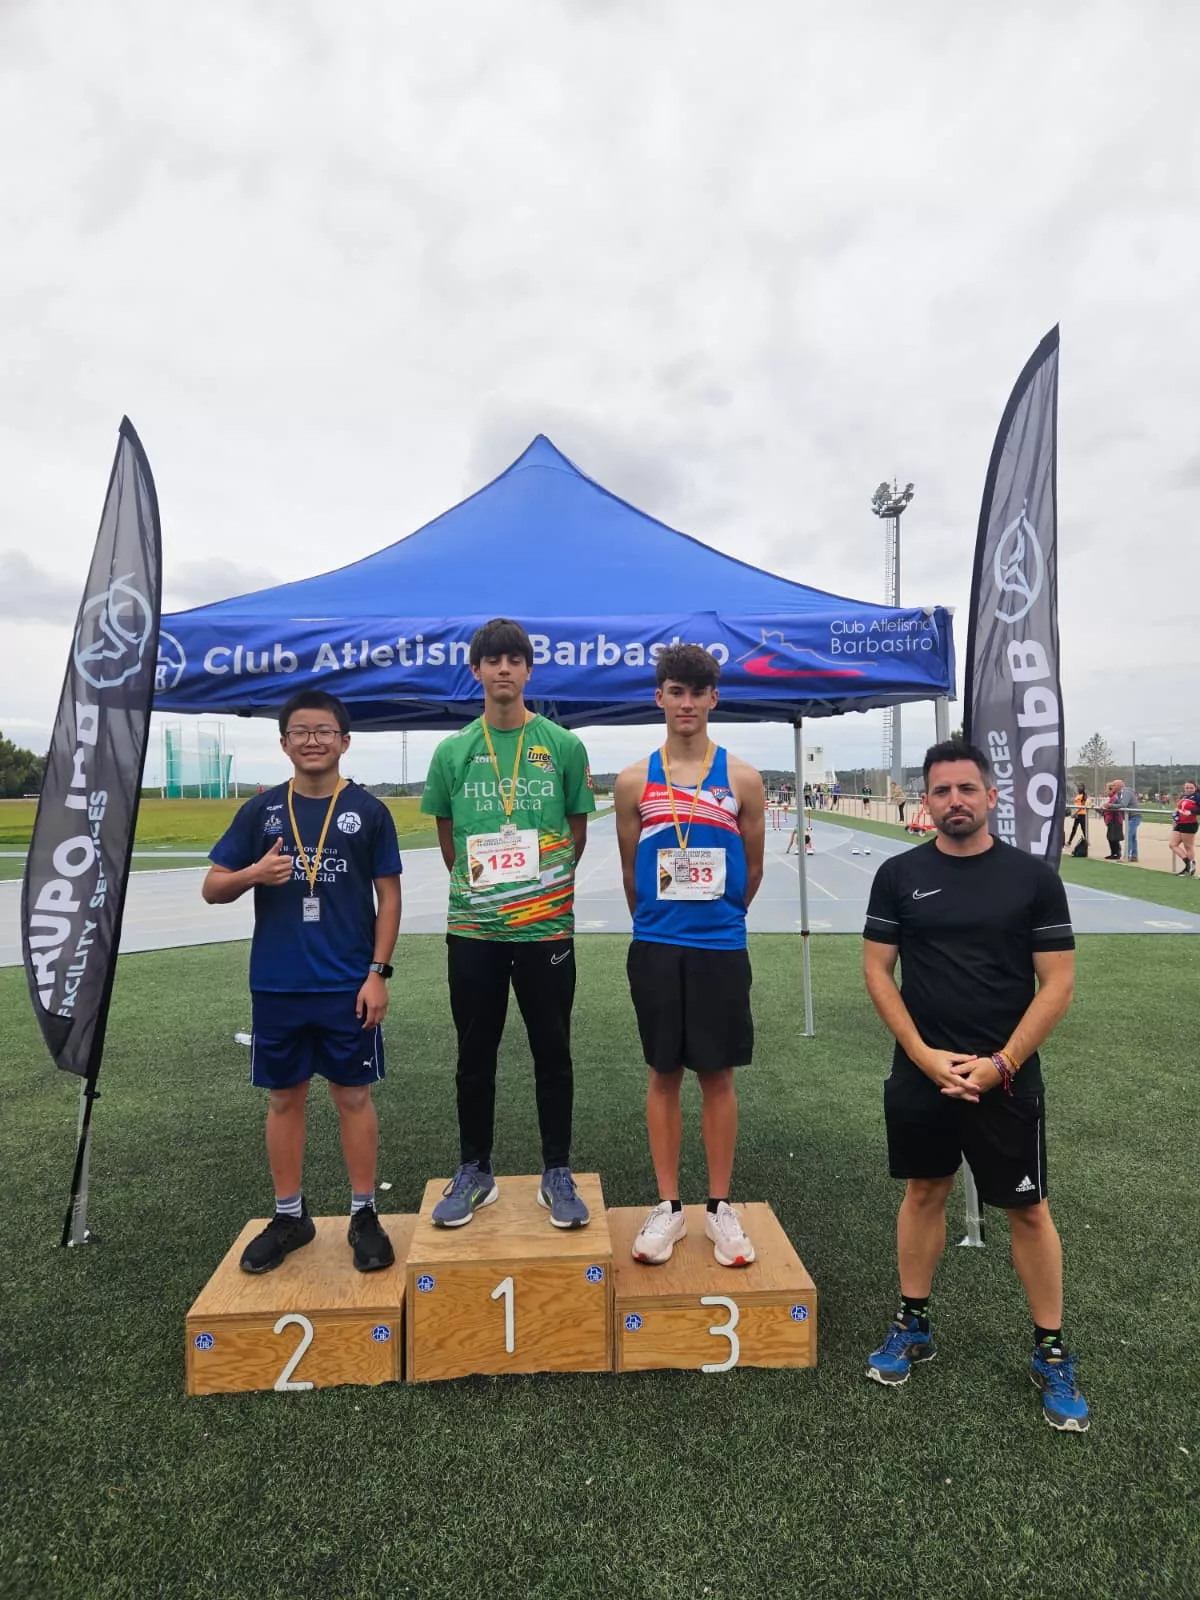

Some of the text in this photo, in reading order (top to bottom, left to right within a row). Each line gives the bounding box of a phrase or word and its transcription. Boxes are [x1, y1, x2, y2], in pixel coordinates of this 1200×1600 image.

[831, 620, 865, 634] Club
[203, 634, 729, 675] Club Atletism Barbaso
[831, 635, 933, 654] Barbastro
[291, 855, 348, 872] esca
[488, 852, 526, 870] 123
[689, 867, 713, 882] 33
[57, 920, 98, 1017] FACILITY
[491, 1276, 514, 1353] 1
[701, 1296, 740, 1373] 3
[273, 1313, 314, 1391] 2
